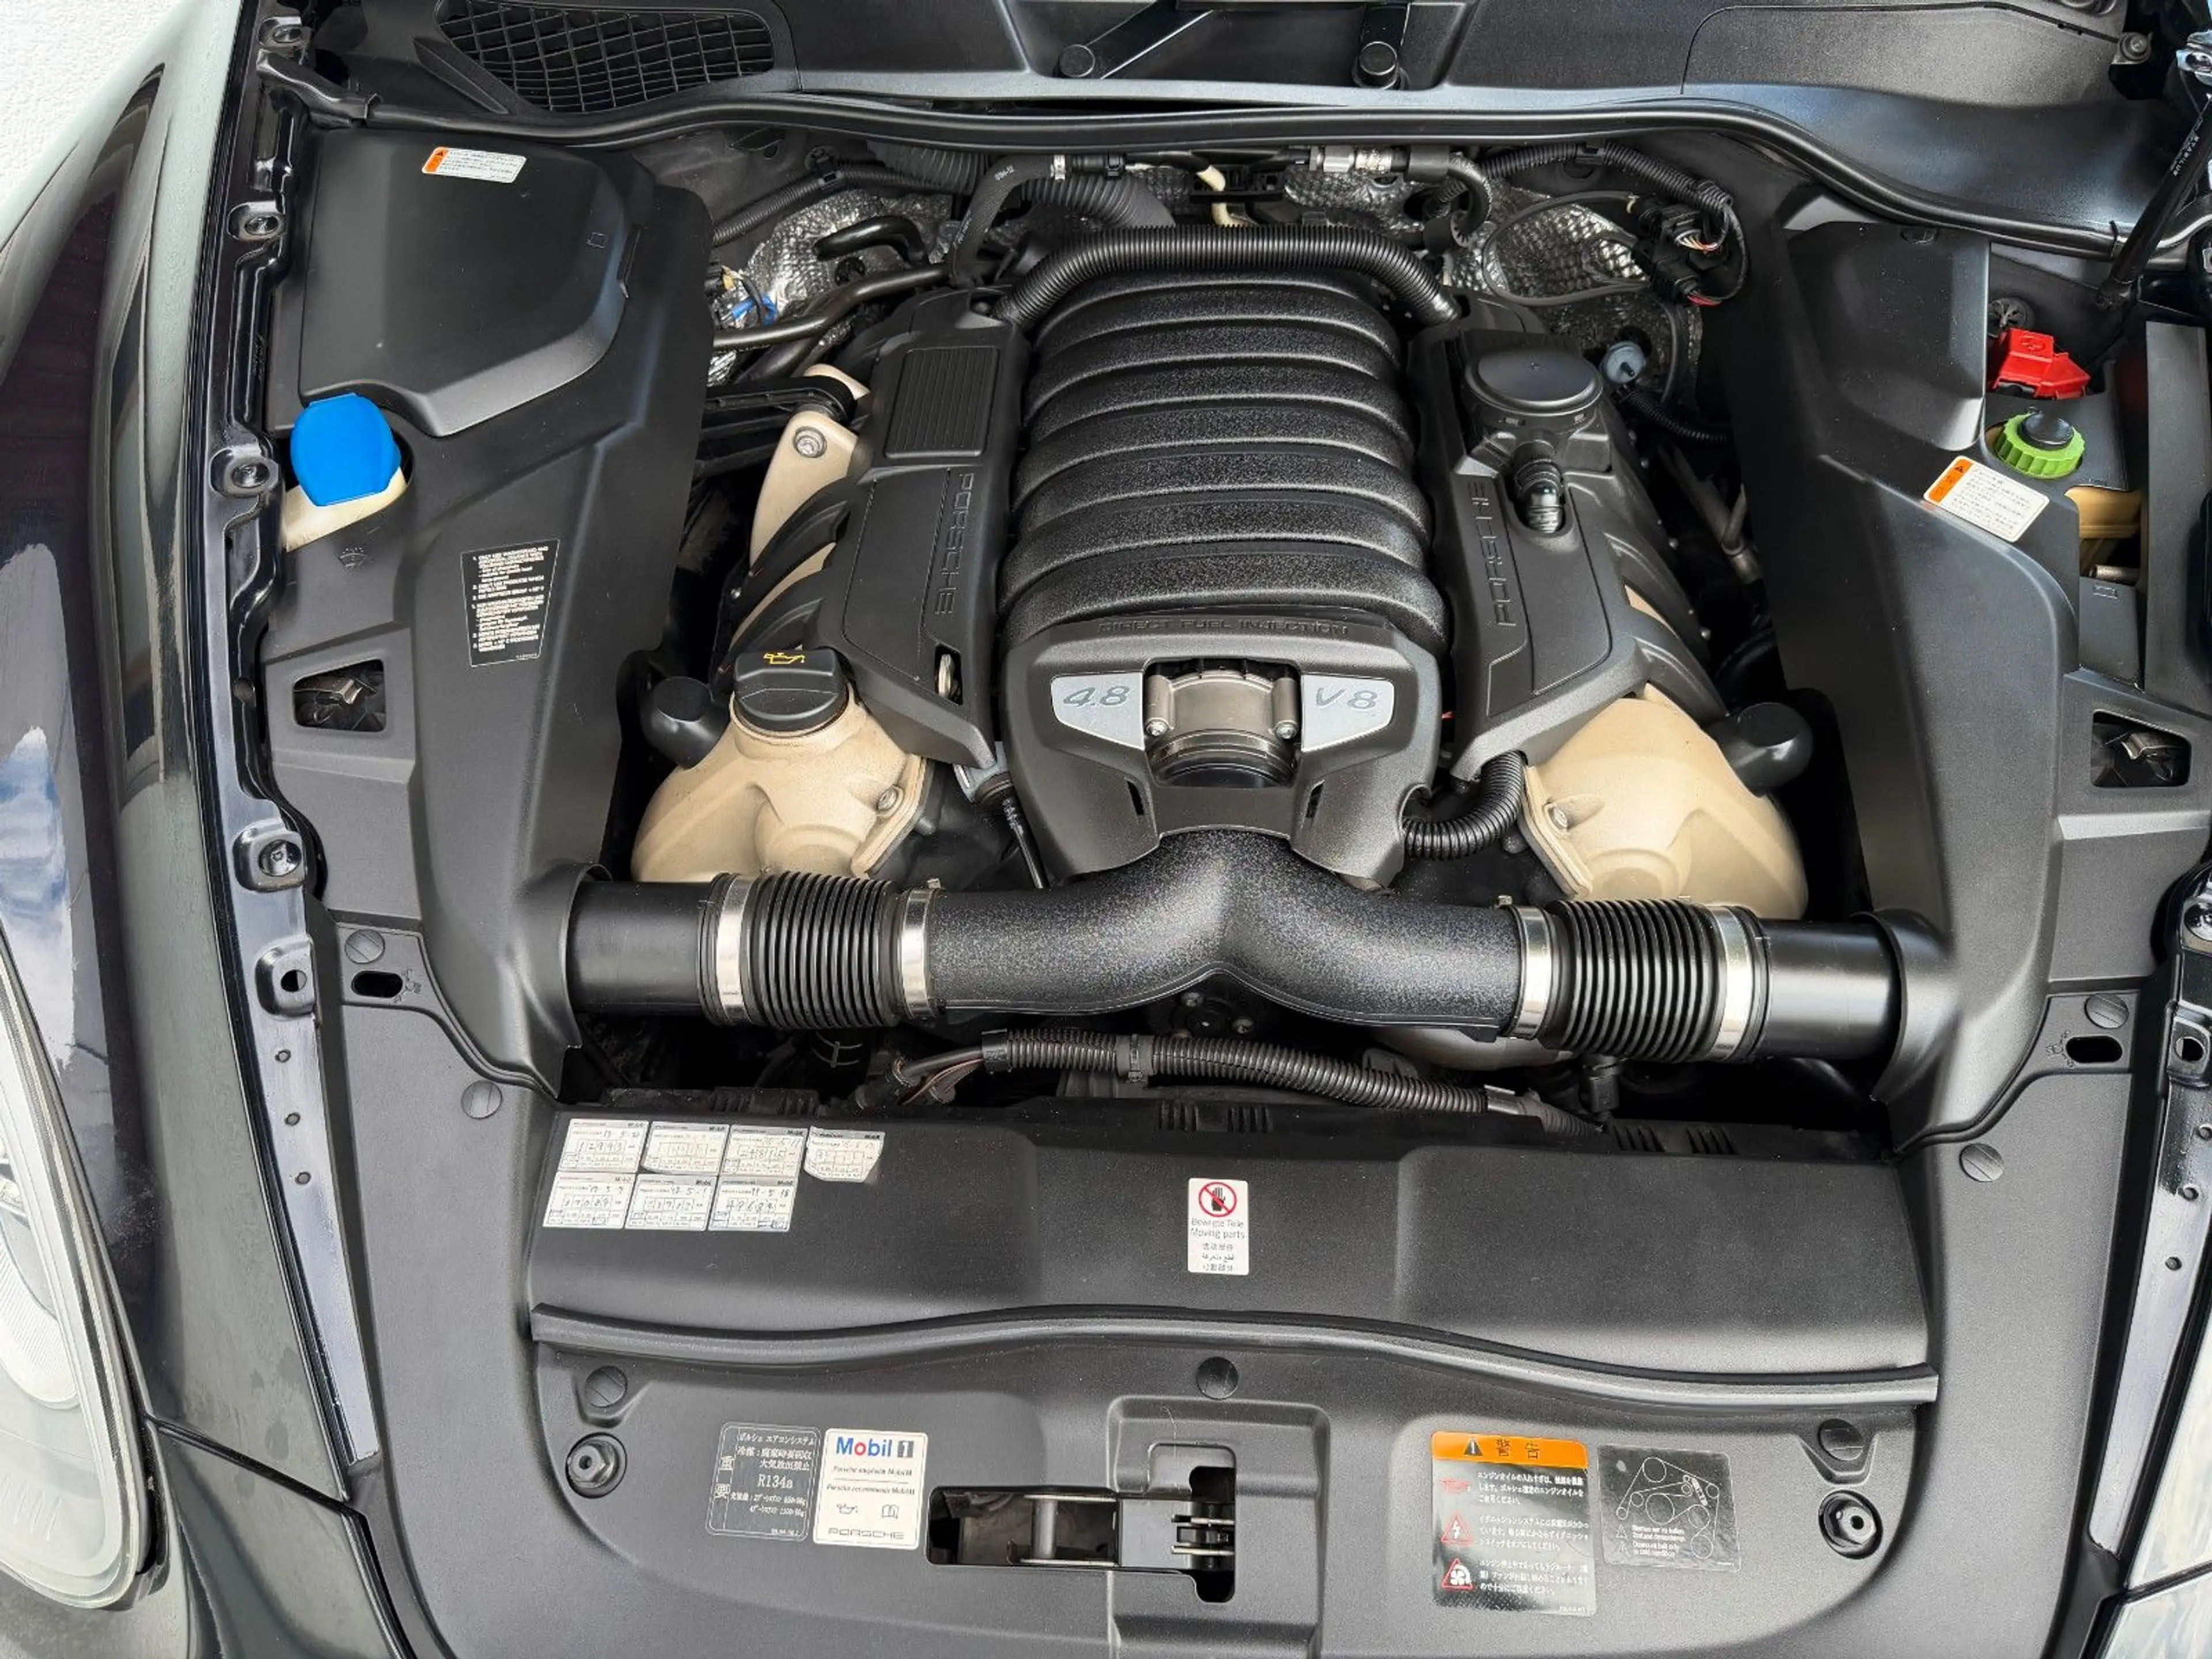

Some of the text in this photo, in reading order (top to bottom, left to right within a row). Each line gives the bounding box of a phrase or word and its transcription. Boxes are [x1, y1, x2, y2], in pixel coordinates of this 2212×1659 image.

[934, 473, 974, 615] PORSCHE
[1469, 482, 1516, 626] PORSCHE
[1099, 619, 1349, 634] DIRECT FUEL INJECTION
[1063, 686, 1130, 707] 4.8
[1316, 687, 1378, 709] V8
[1191, 1228, 1245, 1240] Moving parts
[836, 1437, 914, 1458] Mobil 1
[757, 1474, 793, 1488] R134a
[828, 1528, 904, 1539] PORSCHE
